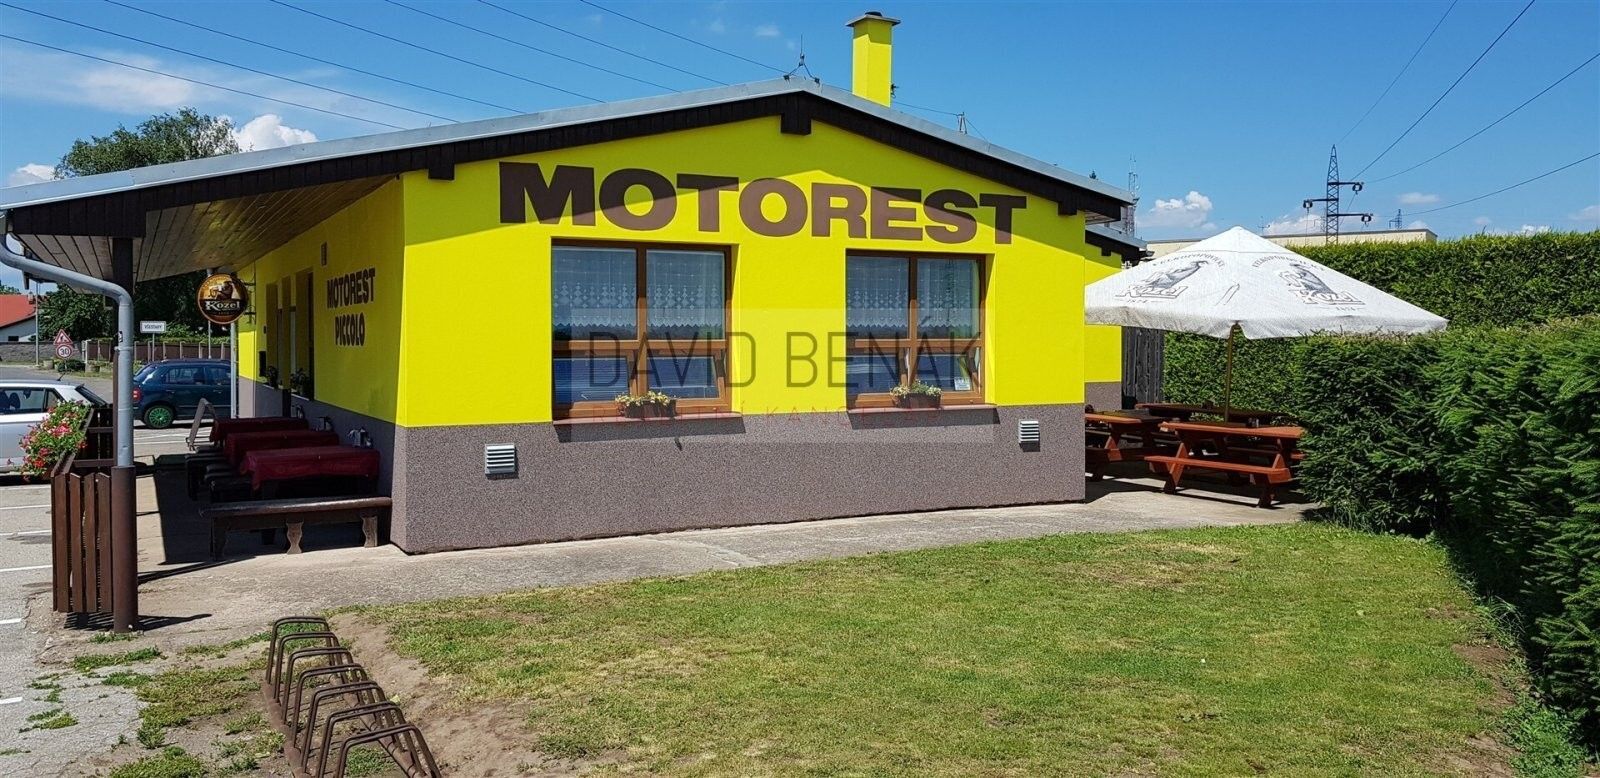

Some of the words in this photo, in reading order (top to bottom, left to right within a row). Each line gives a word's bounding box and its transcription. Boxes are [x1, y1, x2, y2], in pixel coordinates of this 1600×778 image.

[499, 161, 1027, 245] MOTOREST
[205, 300, 240, 311] Kozel
[326, 267, 376, 309] MOTOREST
[334, 312, 366, 347] PICCOLO
[59, 348, 70, 356] 30
